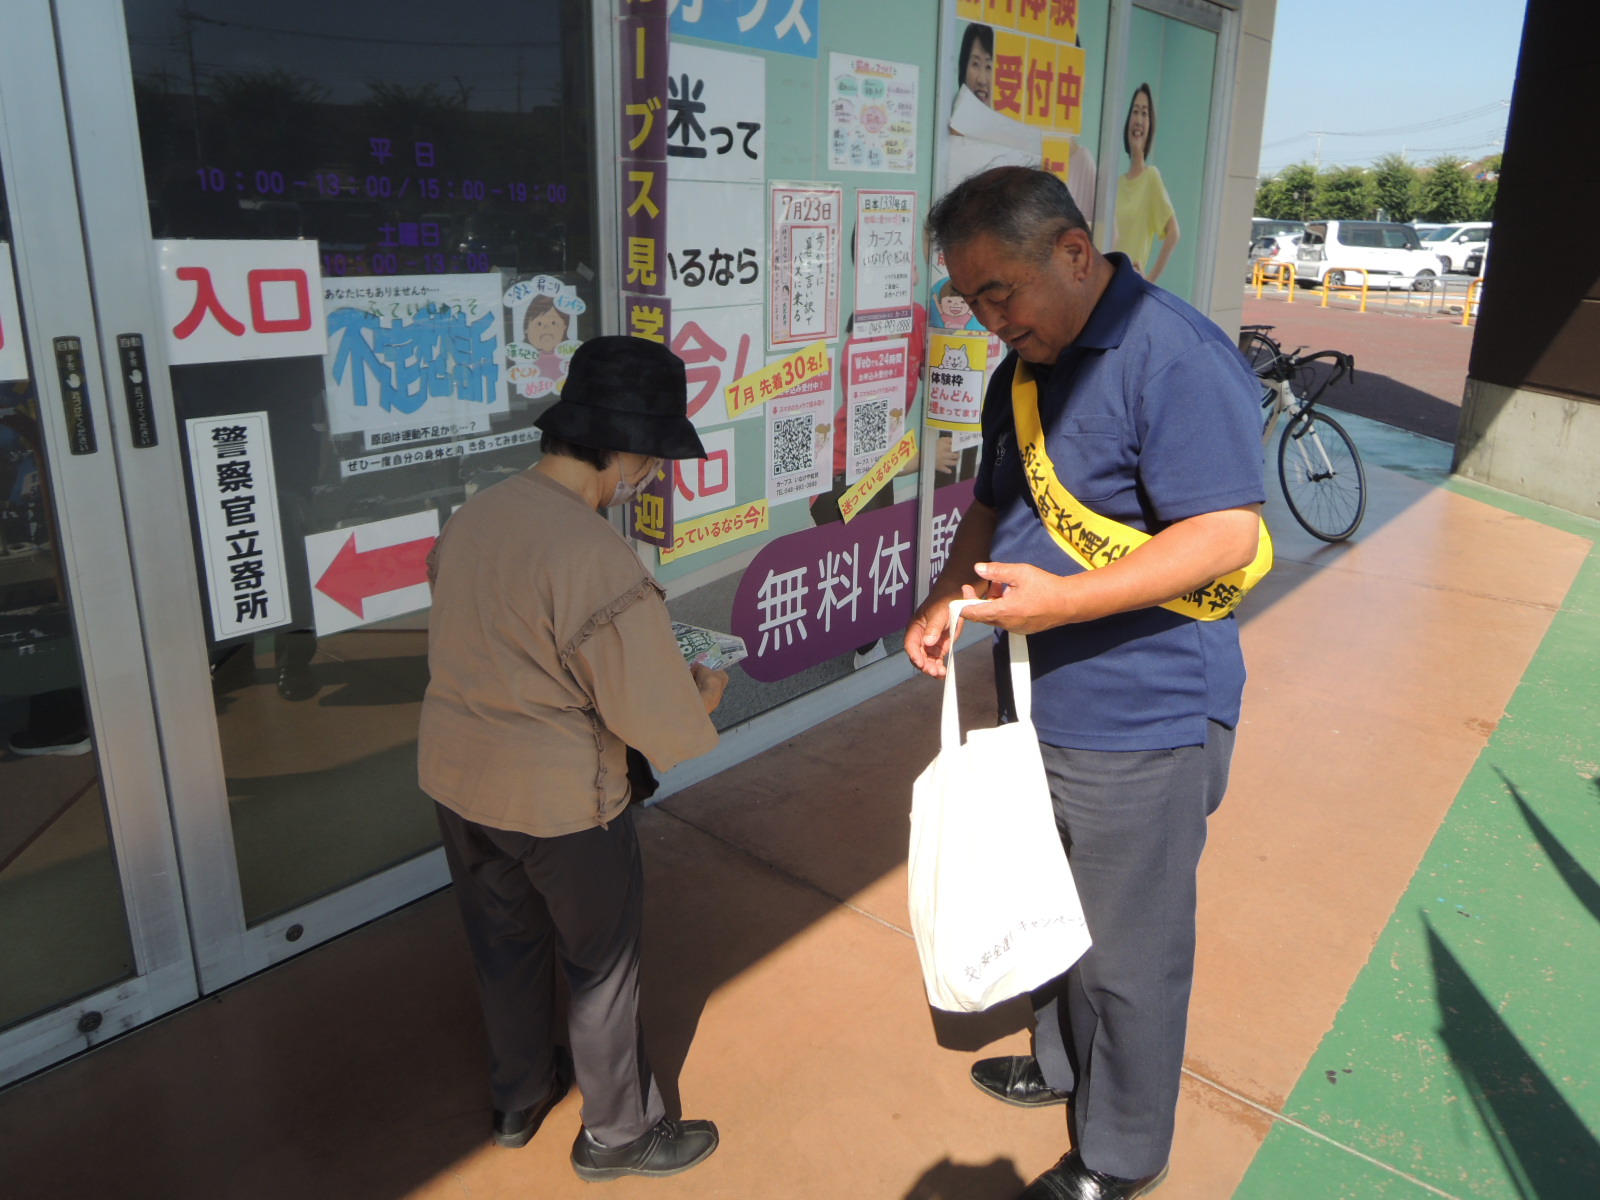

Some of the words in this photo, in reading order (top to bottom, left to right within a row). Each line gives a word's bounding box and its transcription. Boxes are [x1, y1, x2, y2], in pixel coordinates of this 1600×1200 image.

[994, 54, 1082, 120] 受付中
[370, 138, 435, 167] 平日
[782, 195, 832, 221] 7月23日
[378, 222, 440, 247] 土曜日
[868, 230, 904, 248] カーブス
[172, 266, 312, 340] 入口
[729, 385, 755, 411] 7月
[759, 352, 823, 398] 先着30名!
[931, 372, 964, 387] 体験枠
[929, 401, 979, 417] 埋まってます
[930, 388, 974, 403] どんどん
[842, 436, 916, 516] 迷っているなら今!
[211, 425, 269, 623] 警察官立寄所
[662, 506, 765, 555] っているなら今!
